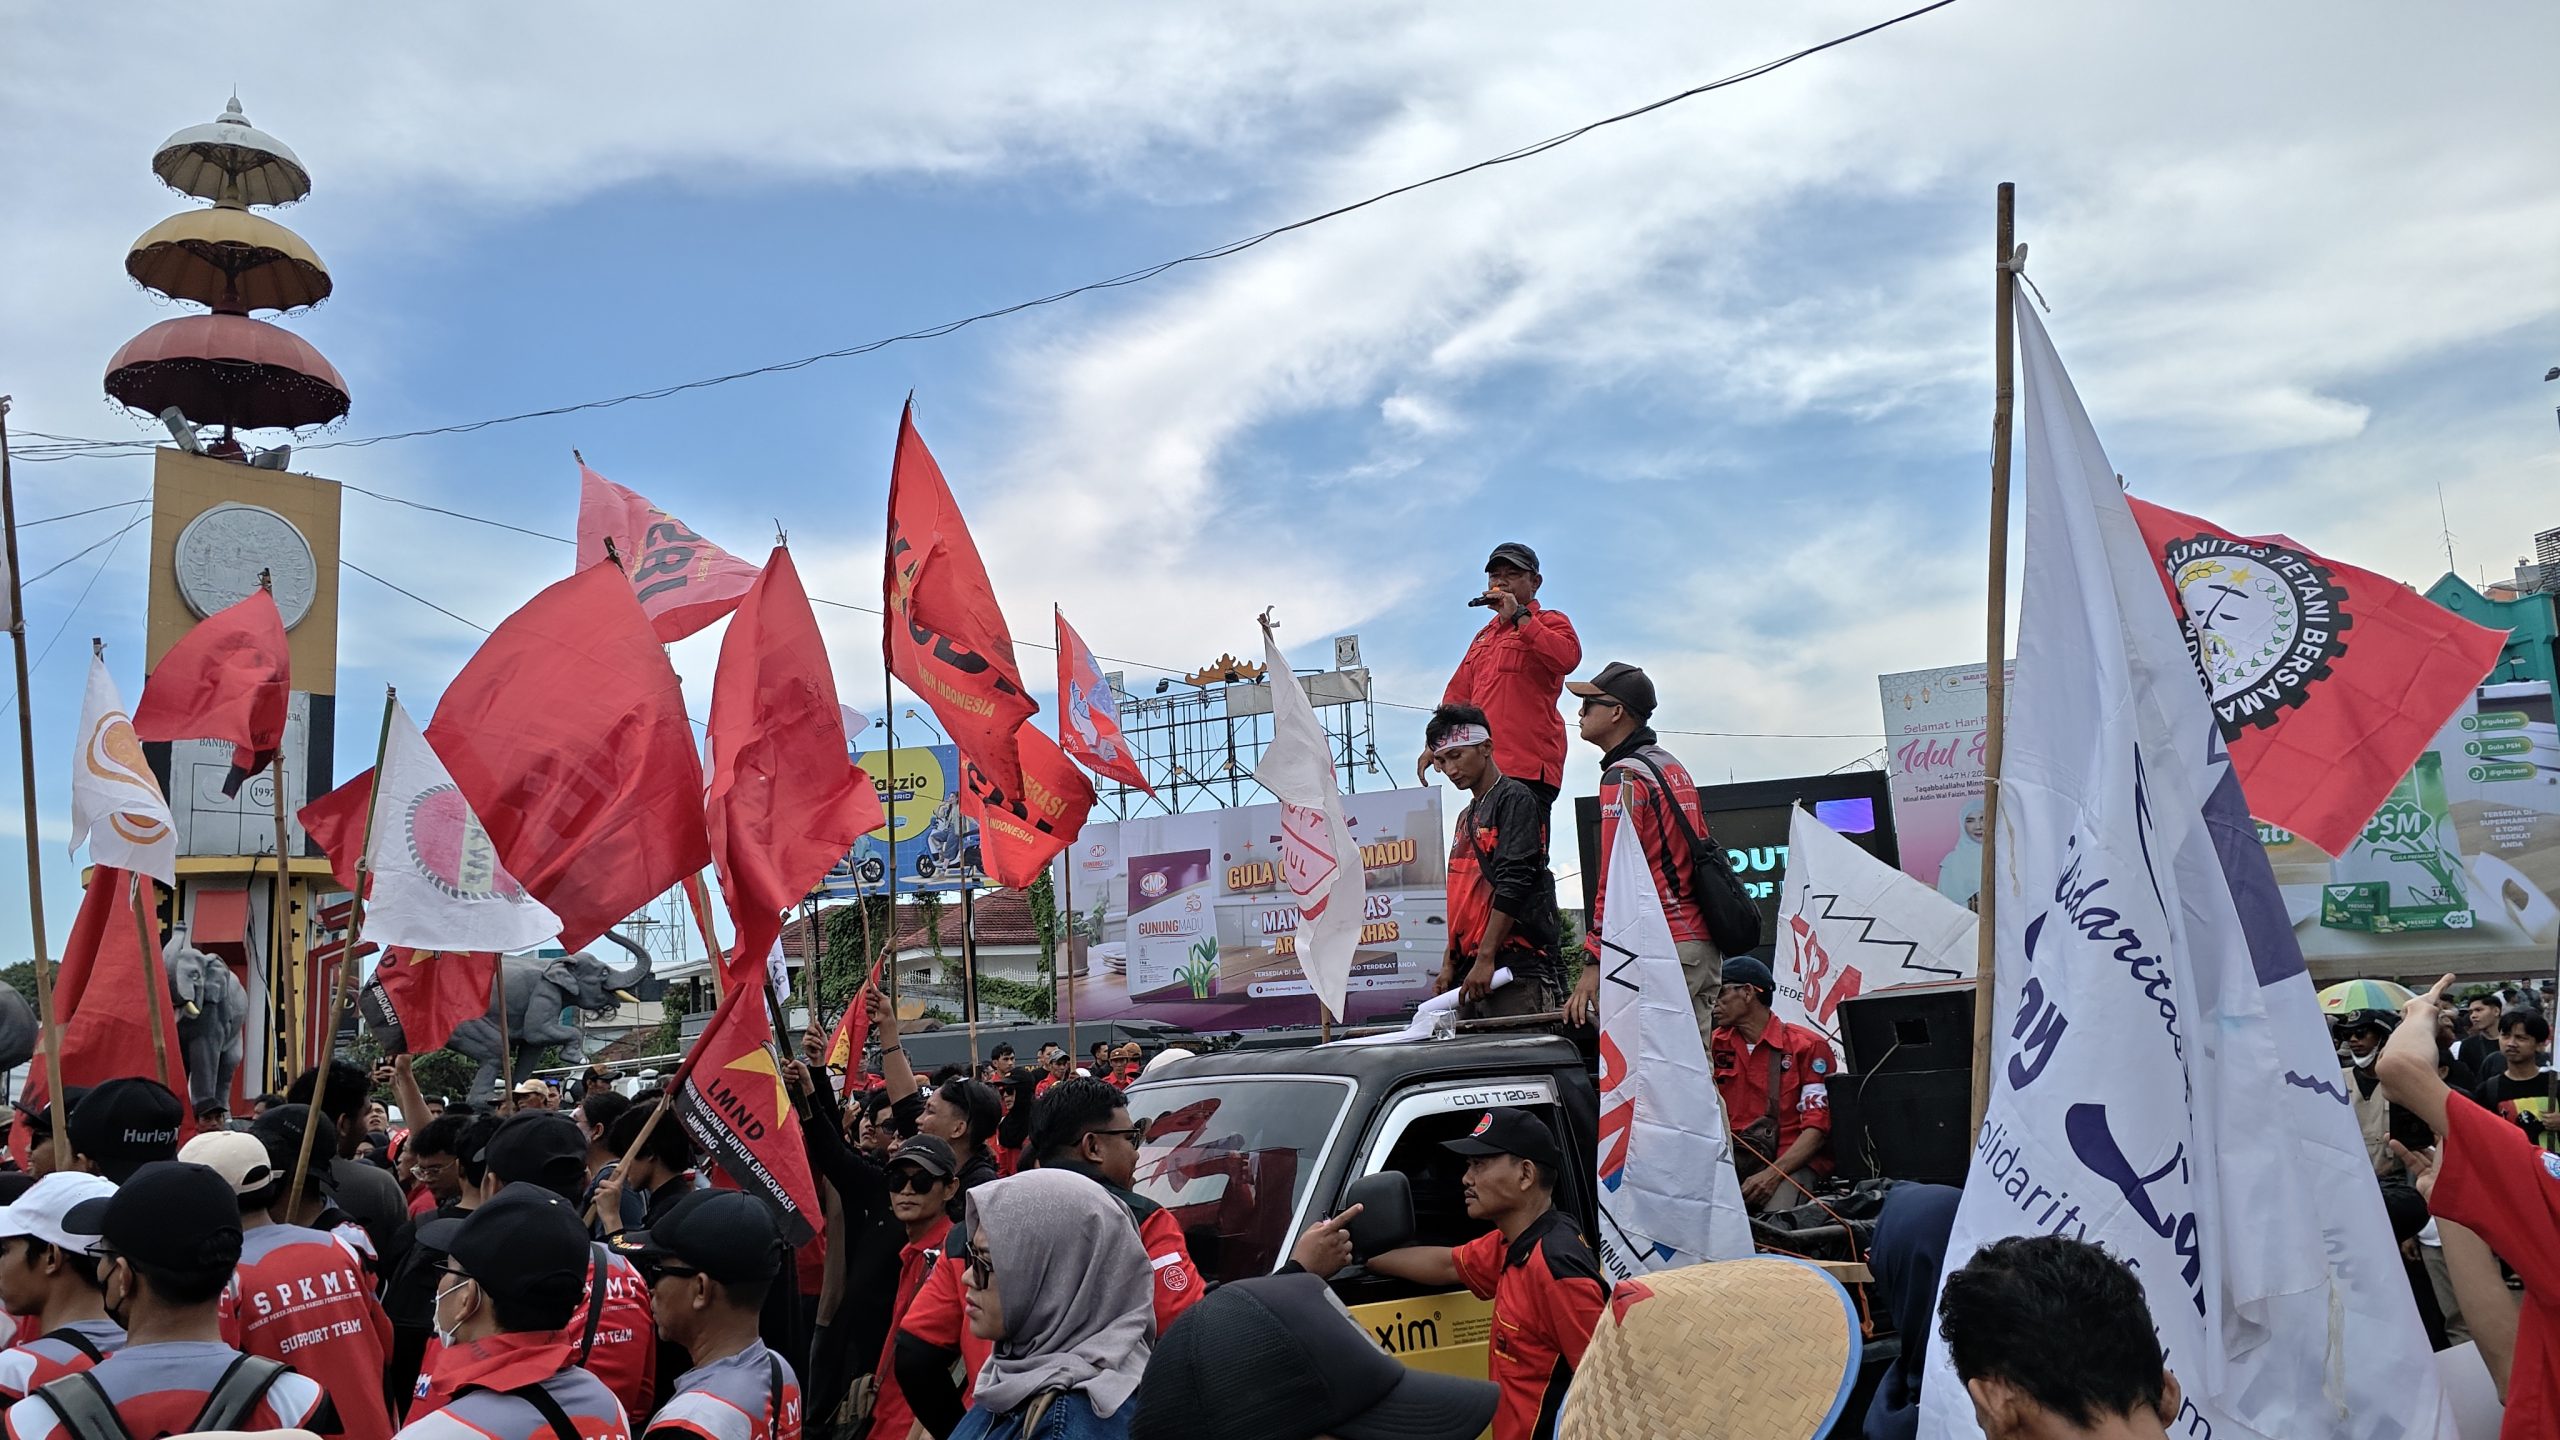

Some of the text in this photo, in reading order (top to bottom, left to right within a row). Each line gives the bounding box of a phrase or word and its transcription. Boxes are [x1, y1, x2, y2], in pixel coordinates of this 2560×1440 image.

[2269, 554, 2331, 623] PETANI
[2216, 627, 2329, 723] BERSAMA
[937, 679, 997, 718] INDONESIA
[1903, 721, 1951, 733] Selamat
[1955, 716, 1979, 728] Hari
[1897, 738, 1961, 774] Idul
[1967, 780, 1985, 788] Minn
[988, 817, 1034, 845] INDONESIA
[2362, 811, 2422, 837] PSM
[1360, 838, 1417, 869] MADU
[2500, 841, 2524, 849] ANDA
[1228, 861, 1275, 890] GULA
[1363, 894, 1391, 920] AS
[1254, 970, 1282, 978] TERSEDIA
[1363, 962, 1396, 971] TERDEKAT
[1398, 961, 1417, 969] ANDA
[371, 985, 399, 1026] DEMOKRASI
[706, 1078, 765, 1142] LMND
[1452, 1093, 1490, 1106] COLT
[123, 1128, 174, 1145] Hurley
[694, 1096, 725, 1137] NASIONAL
[725, 1132, 756, 1167] UNTUK
[750, 1161, 798, 1214] DEMOKRASI
[280, 1318, 362, 1354] SUPPORT TEAM
[607, 1328, 633, 1343] TEAM
